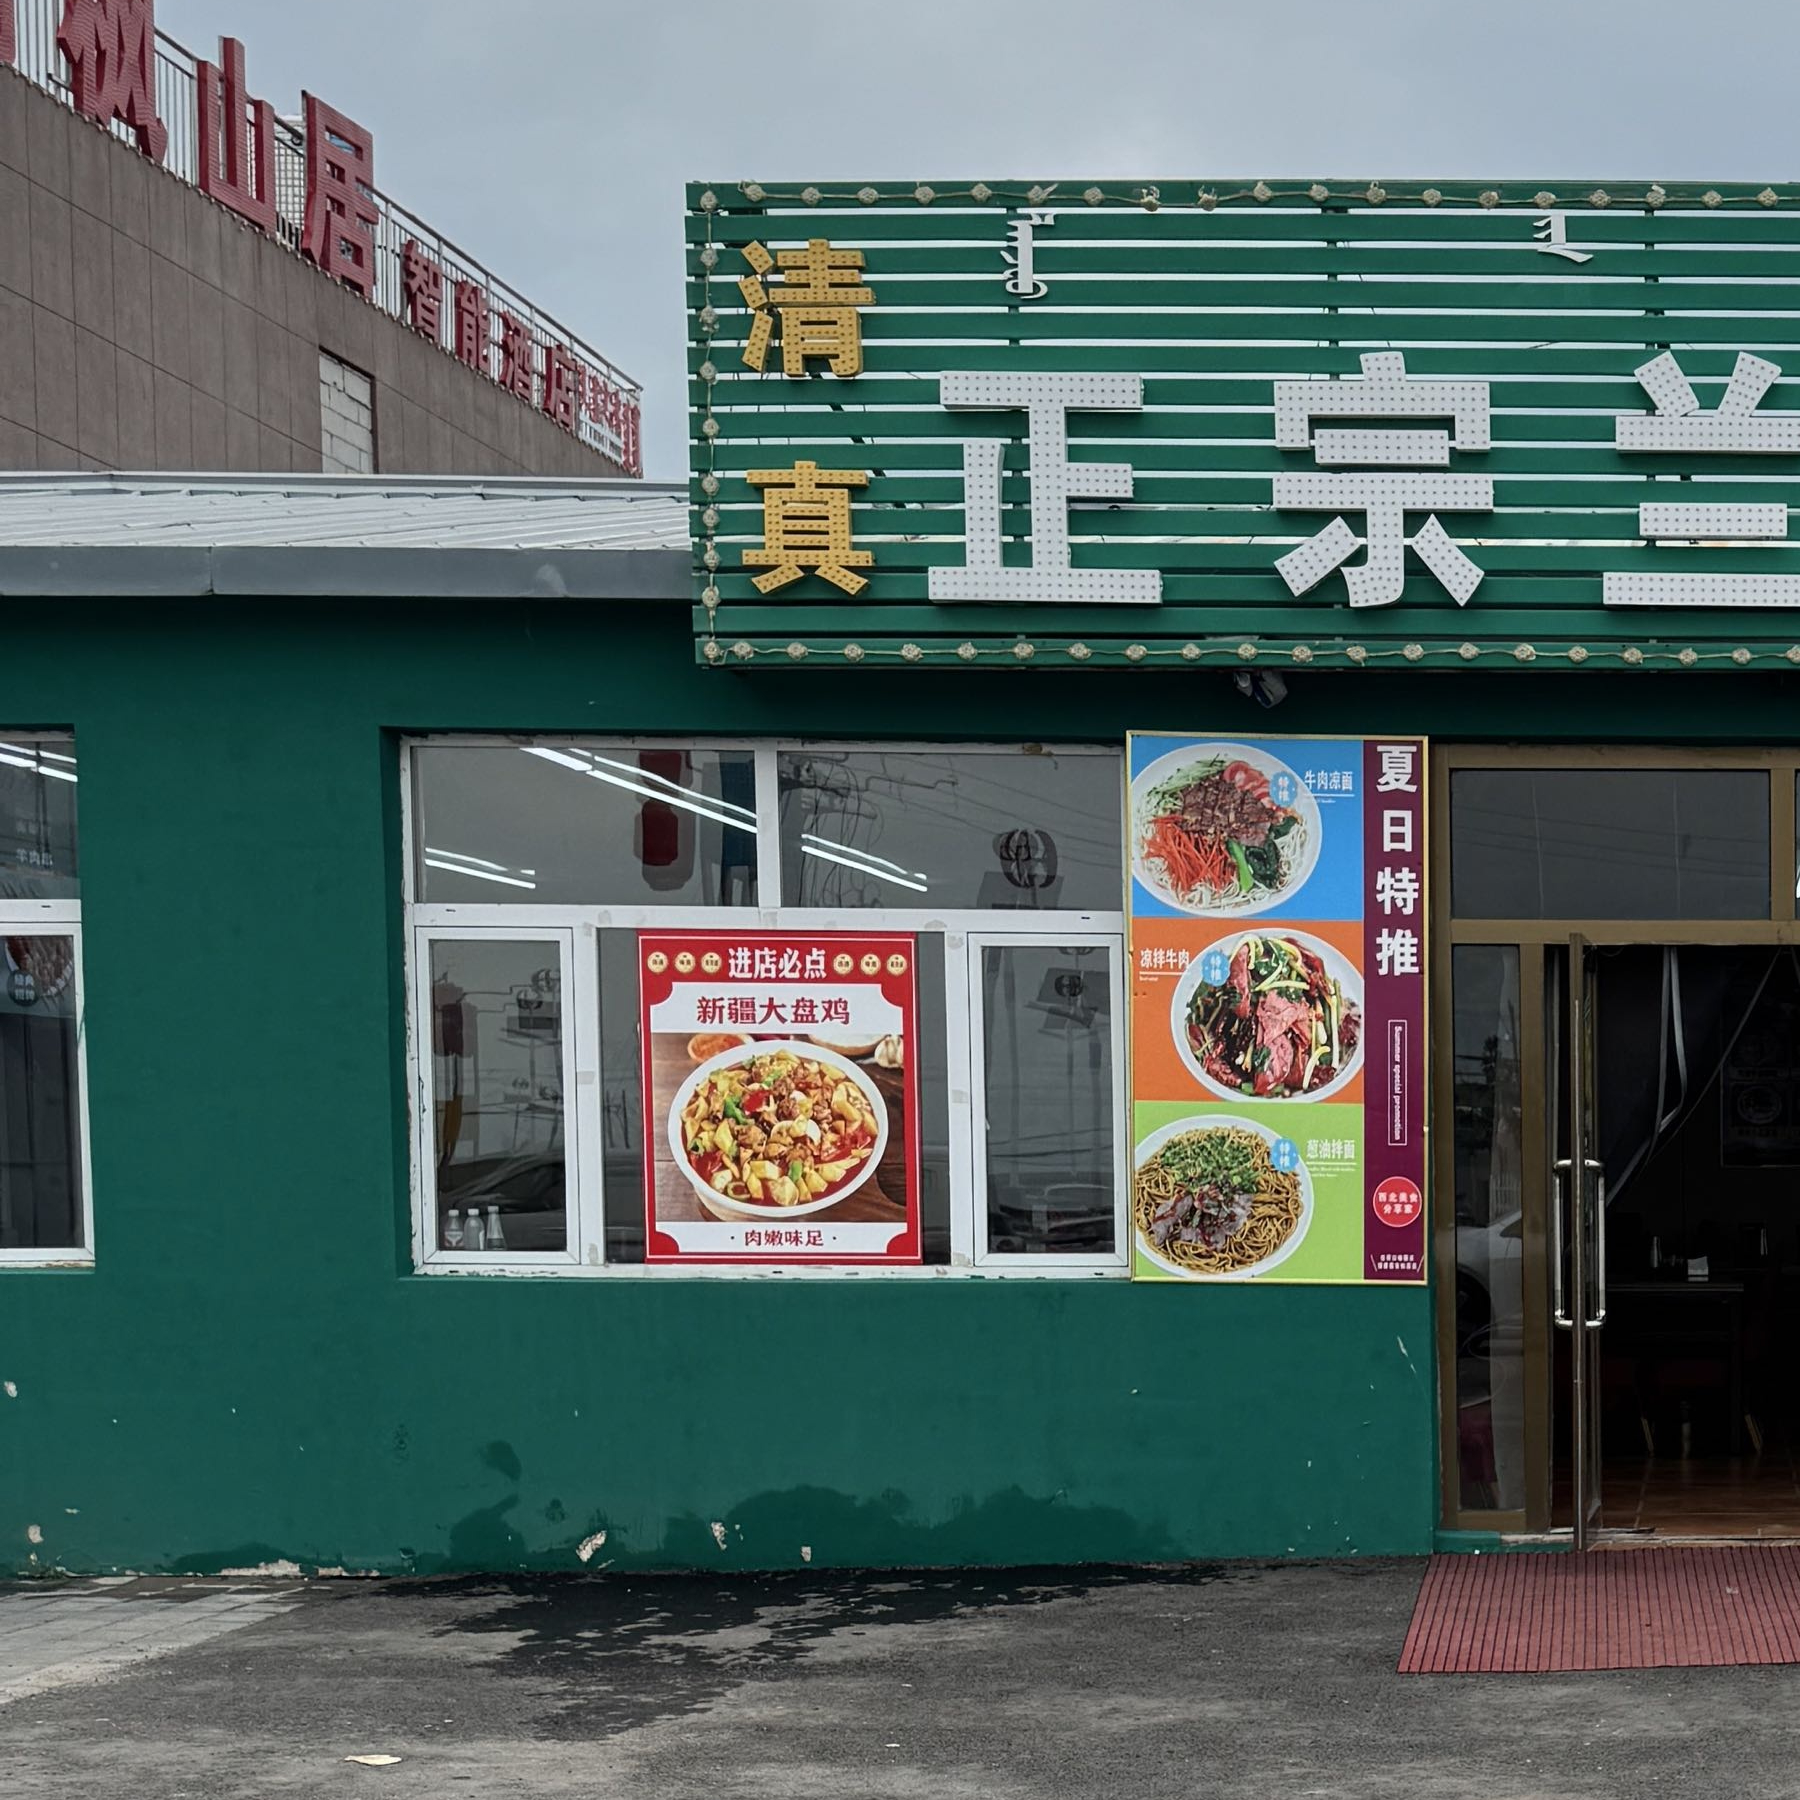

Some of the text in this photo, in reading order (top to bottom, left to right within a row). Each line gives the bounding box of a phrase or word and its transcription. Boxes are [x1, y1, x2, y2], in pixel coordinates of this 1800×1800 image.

[0, 0, 378, 301] 枫山居
[403, 239, 578, 429] 智能酒店
[738, 238, 875, 595] 清真
[1304, 769, 1353, 791] 牛肉凉面
[1376, 745, 1420, 976] 夏日特推
[728, 946, 827, 979] 进店必点
[1140, 948, 1190, 970] 凉拌牛肉
[696, 996, 851, 1026] 新疆大盘鸡
[1306, 1138, 1355, 1160] 葱油拌面
[744, 1230, 824, 1247] 肉嫩味足
